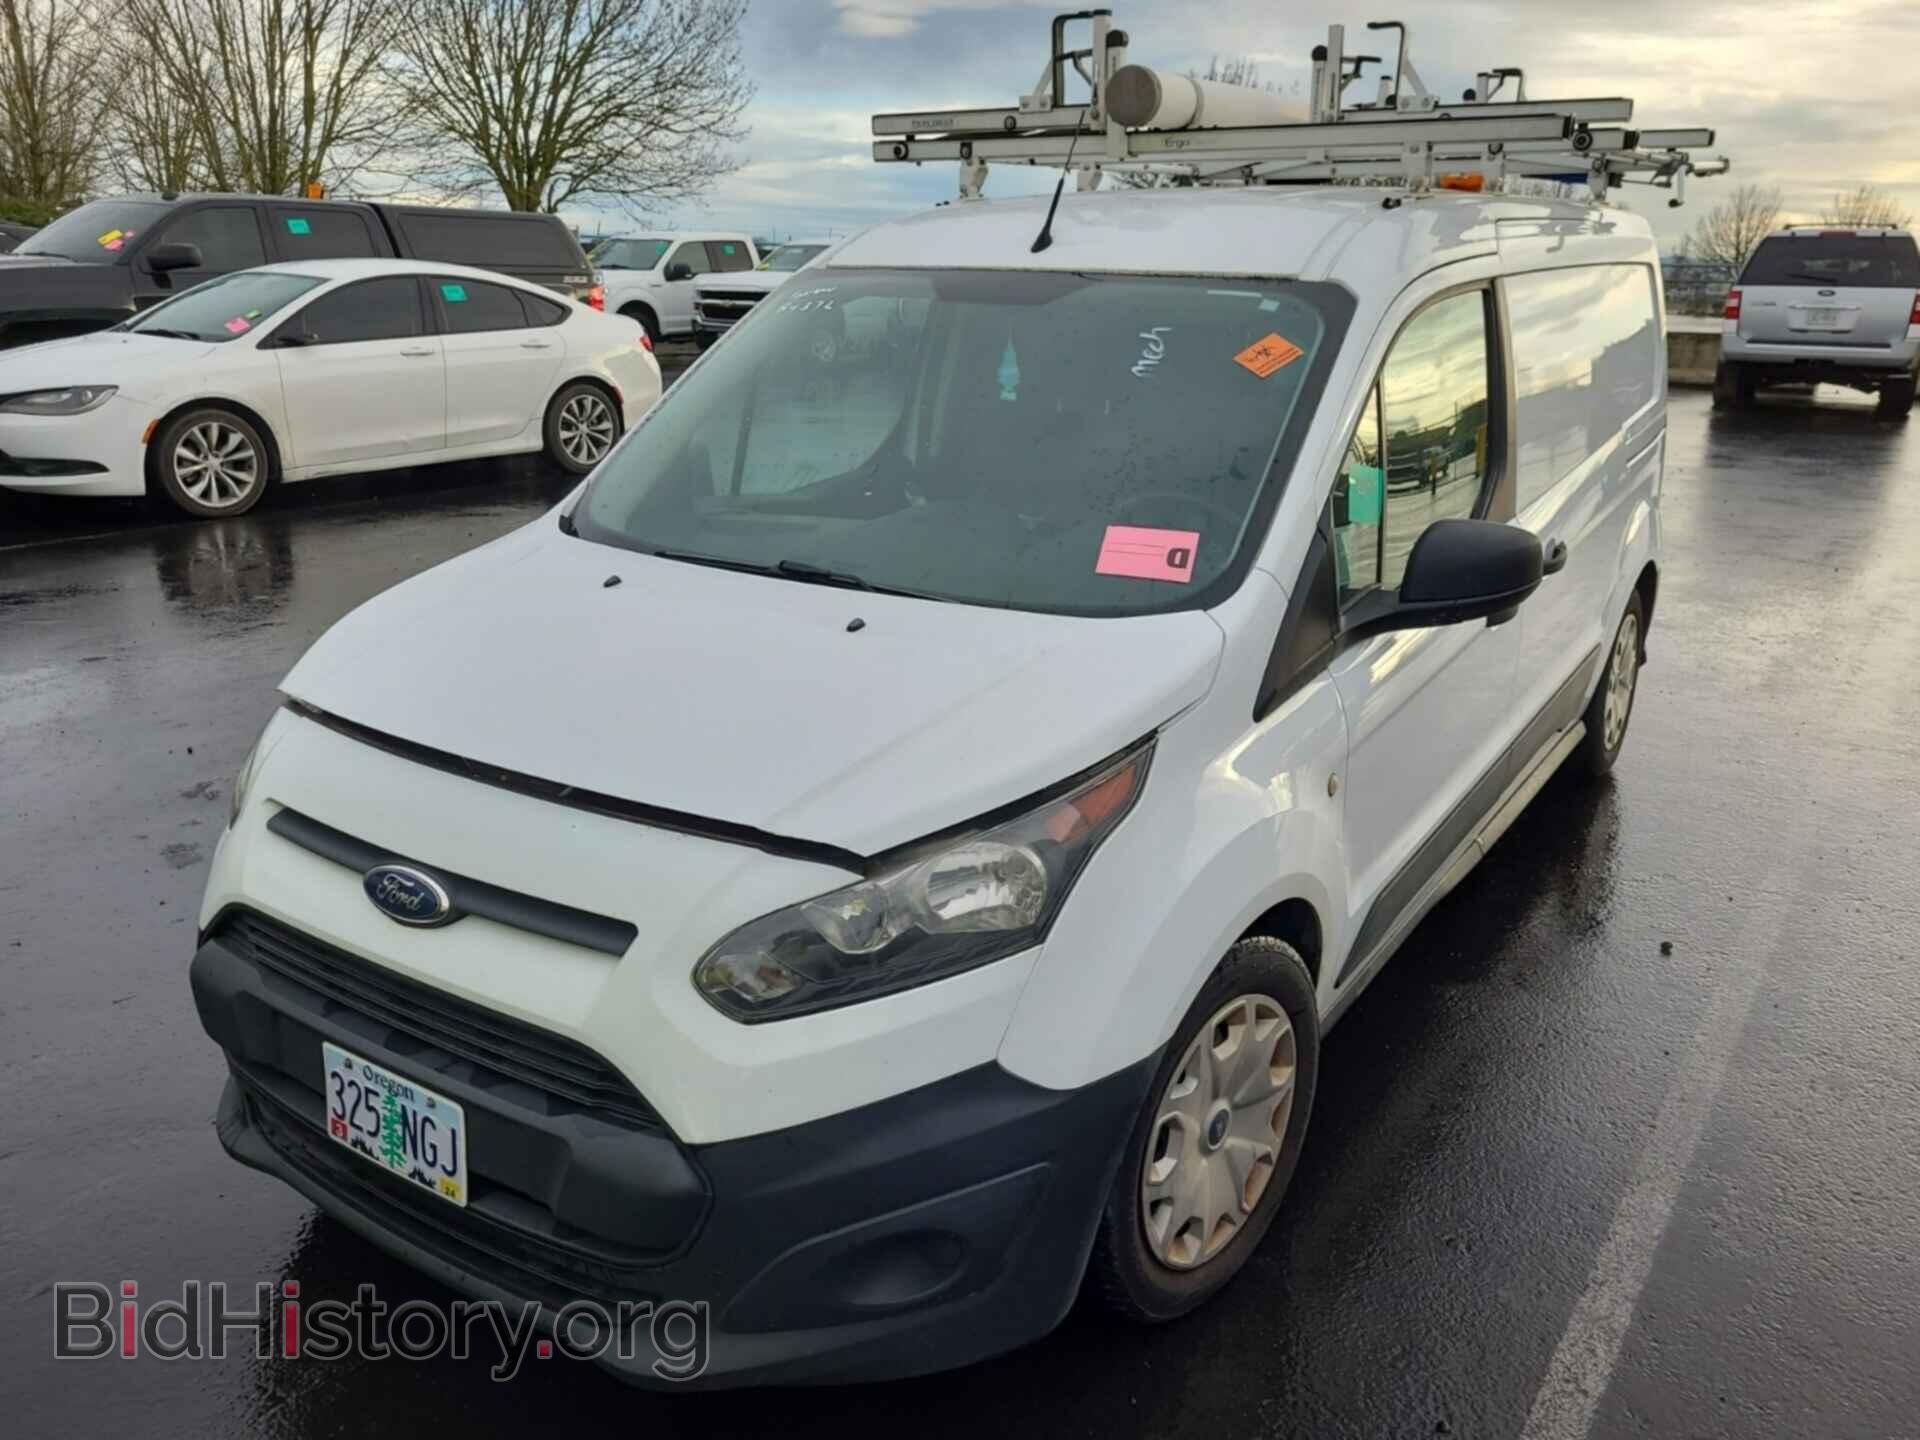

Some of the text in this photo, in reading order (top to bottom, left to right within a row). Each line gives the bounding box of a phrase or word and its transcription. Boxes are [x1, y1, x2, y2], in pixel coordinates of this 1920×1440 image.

[1166, 547, 1191, 569] D
[376, 873, 425, 911] Ford
[362, 1064, 416, 1102] Oregon
[330, 1070, 458, 1178] 325 NGJ
